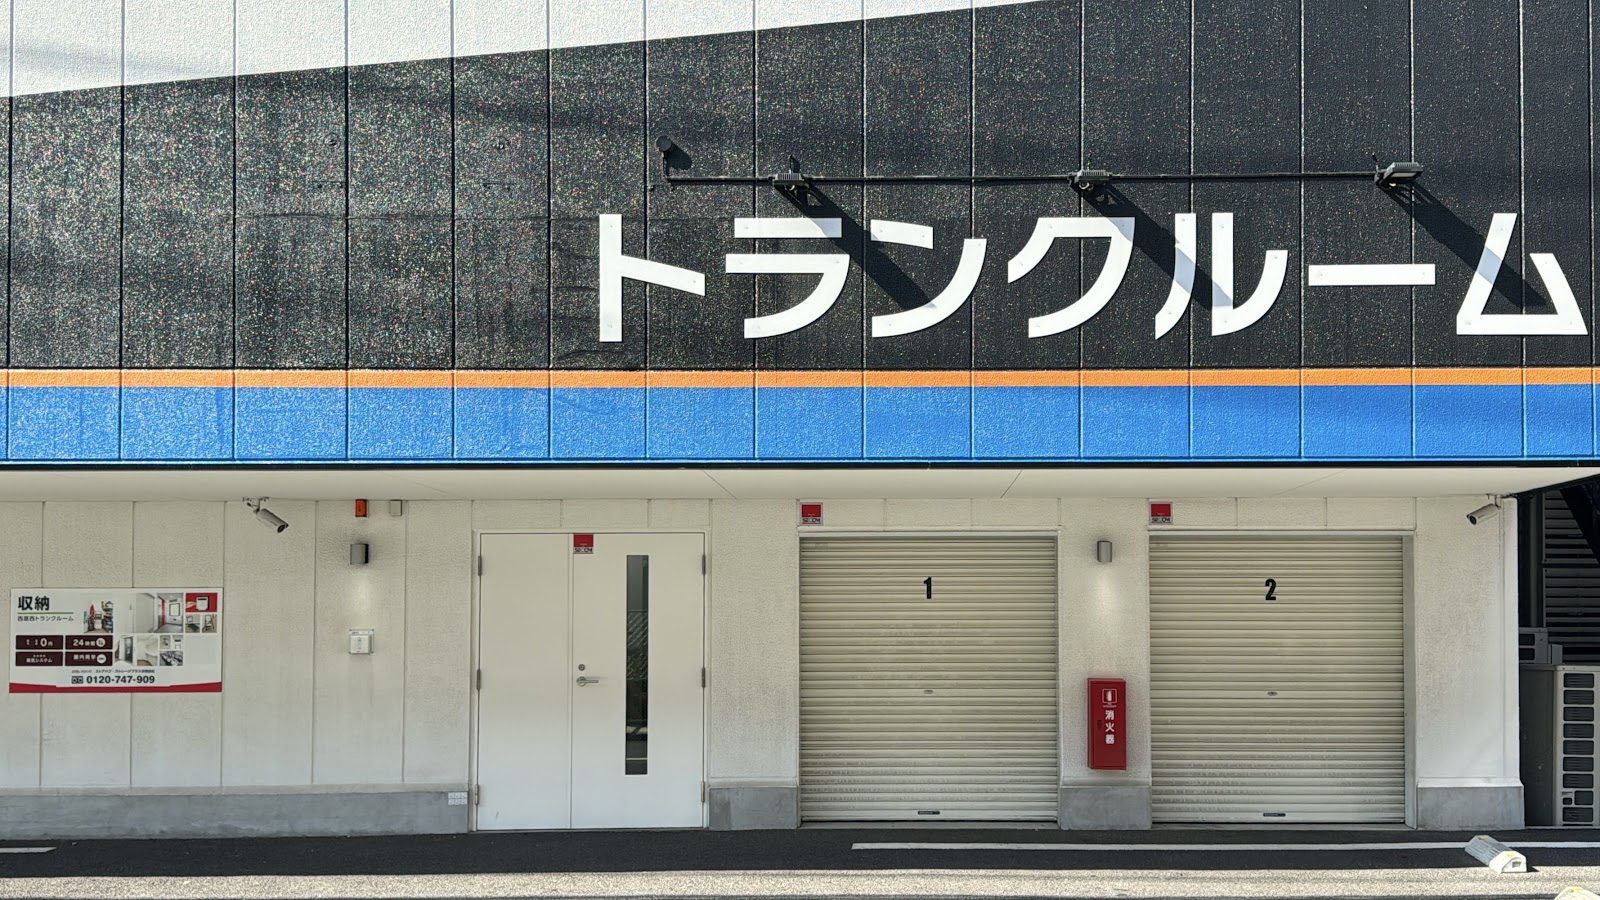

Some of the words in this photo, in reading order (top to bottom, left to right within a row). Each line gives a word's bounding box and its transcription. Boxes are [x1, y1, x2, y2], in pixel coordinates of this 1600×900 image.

[599, 212, 1588, 341] トランクルーム
[923, 576, 932, 599] 1
[1265, 578, 1277, 600] 2
[17, 595, 50, 611] 収納
[86, 676, 155, 684] 0120-747-909
[1105, 710, 1115, 744] 消火器
